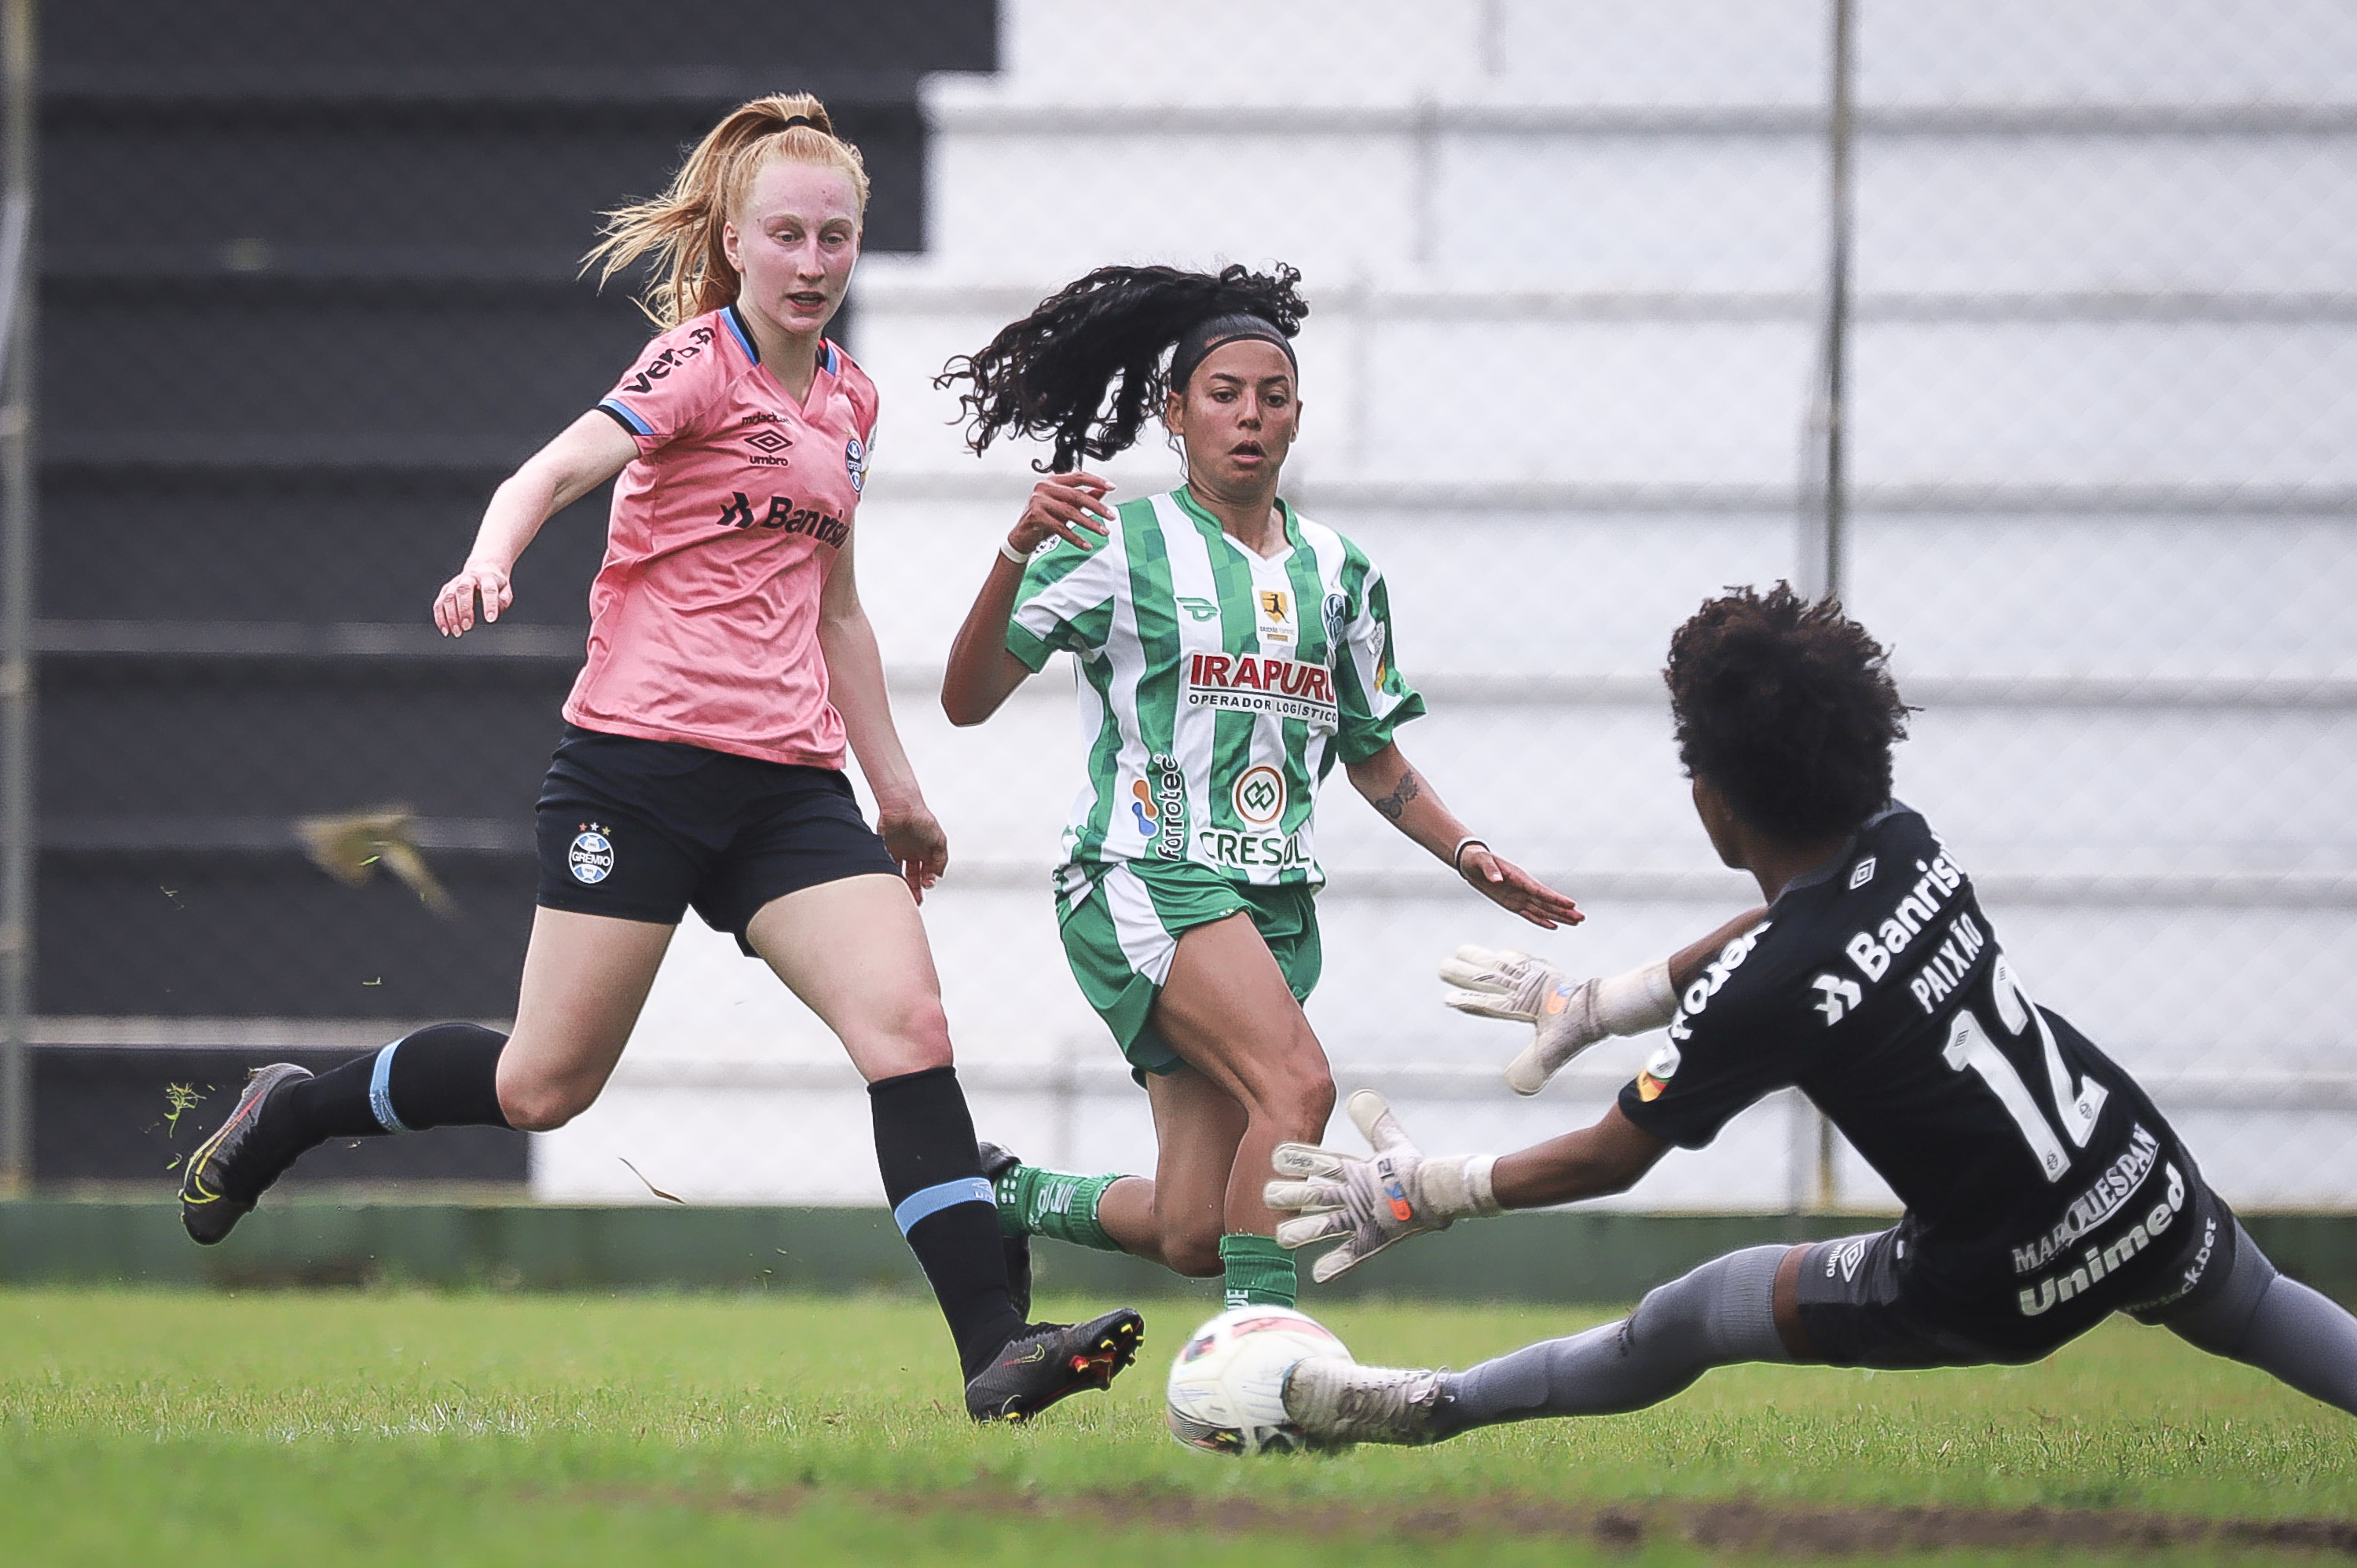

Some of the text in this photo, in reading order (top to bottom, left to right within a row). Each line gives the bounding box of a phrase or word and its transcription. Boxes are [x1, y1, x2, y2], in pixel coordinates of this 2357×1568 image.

[750, 455, 789, 467] umbro
[1189, 694, 1336, 723] OPERADOR LOGÍSTICO
[572, 851, 611, 866] GRÊMIO
[1200, 831, 1310, 866] CRESOL
[1911, 913, 1984, 1014] PAIXÃO
[1942, 954, 2109, 1183] 12
[2019, 1161, 2184, 1316] Unimed
